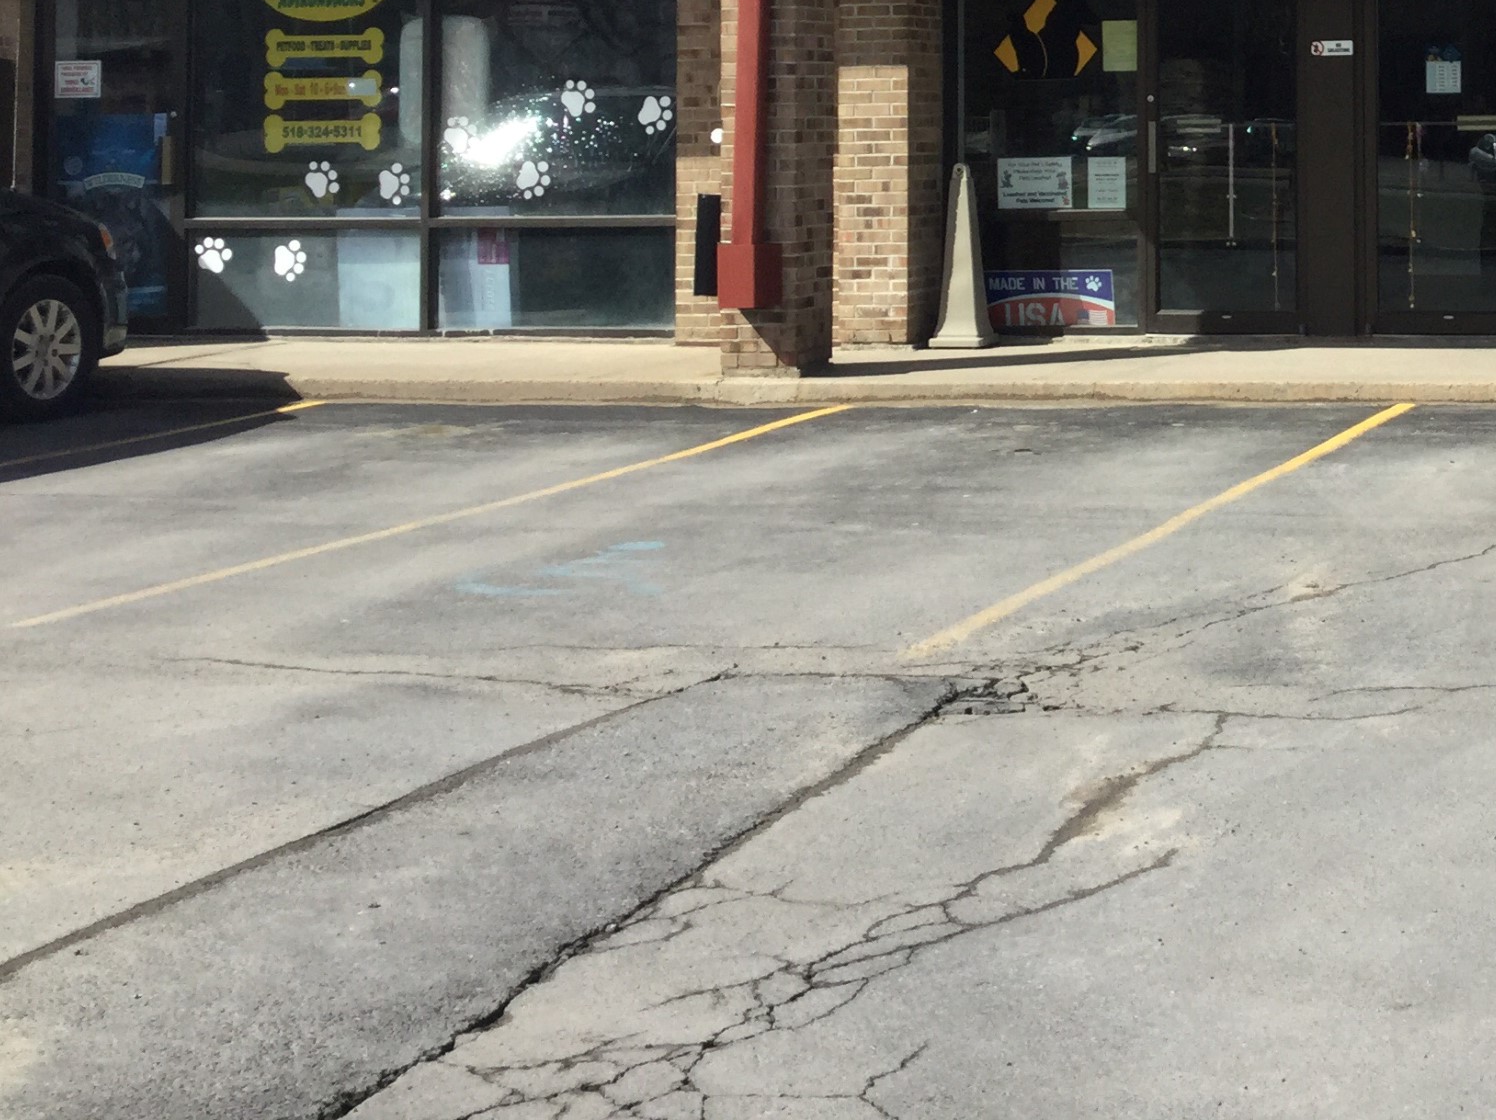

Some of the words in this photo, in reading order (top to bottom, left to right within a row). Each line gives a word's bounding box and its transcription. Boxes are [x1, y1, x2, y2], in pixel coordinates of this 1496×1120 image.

[282, 126, 362, 138] 518-324-5311
[989, 277, 1026, 291] MADE
[1033, 277, 1046, 291] IN
[1052, 277, 1079, 291] THE
[1003, 302, 1067, 327] USA
